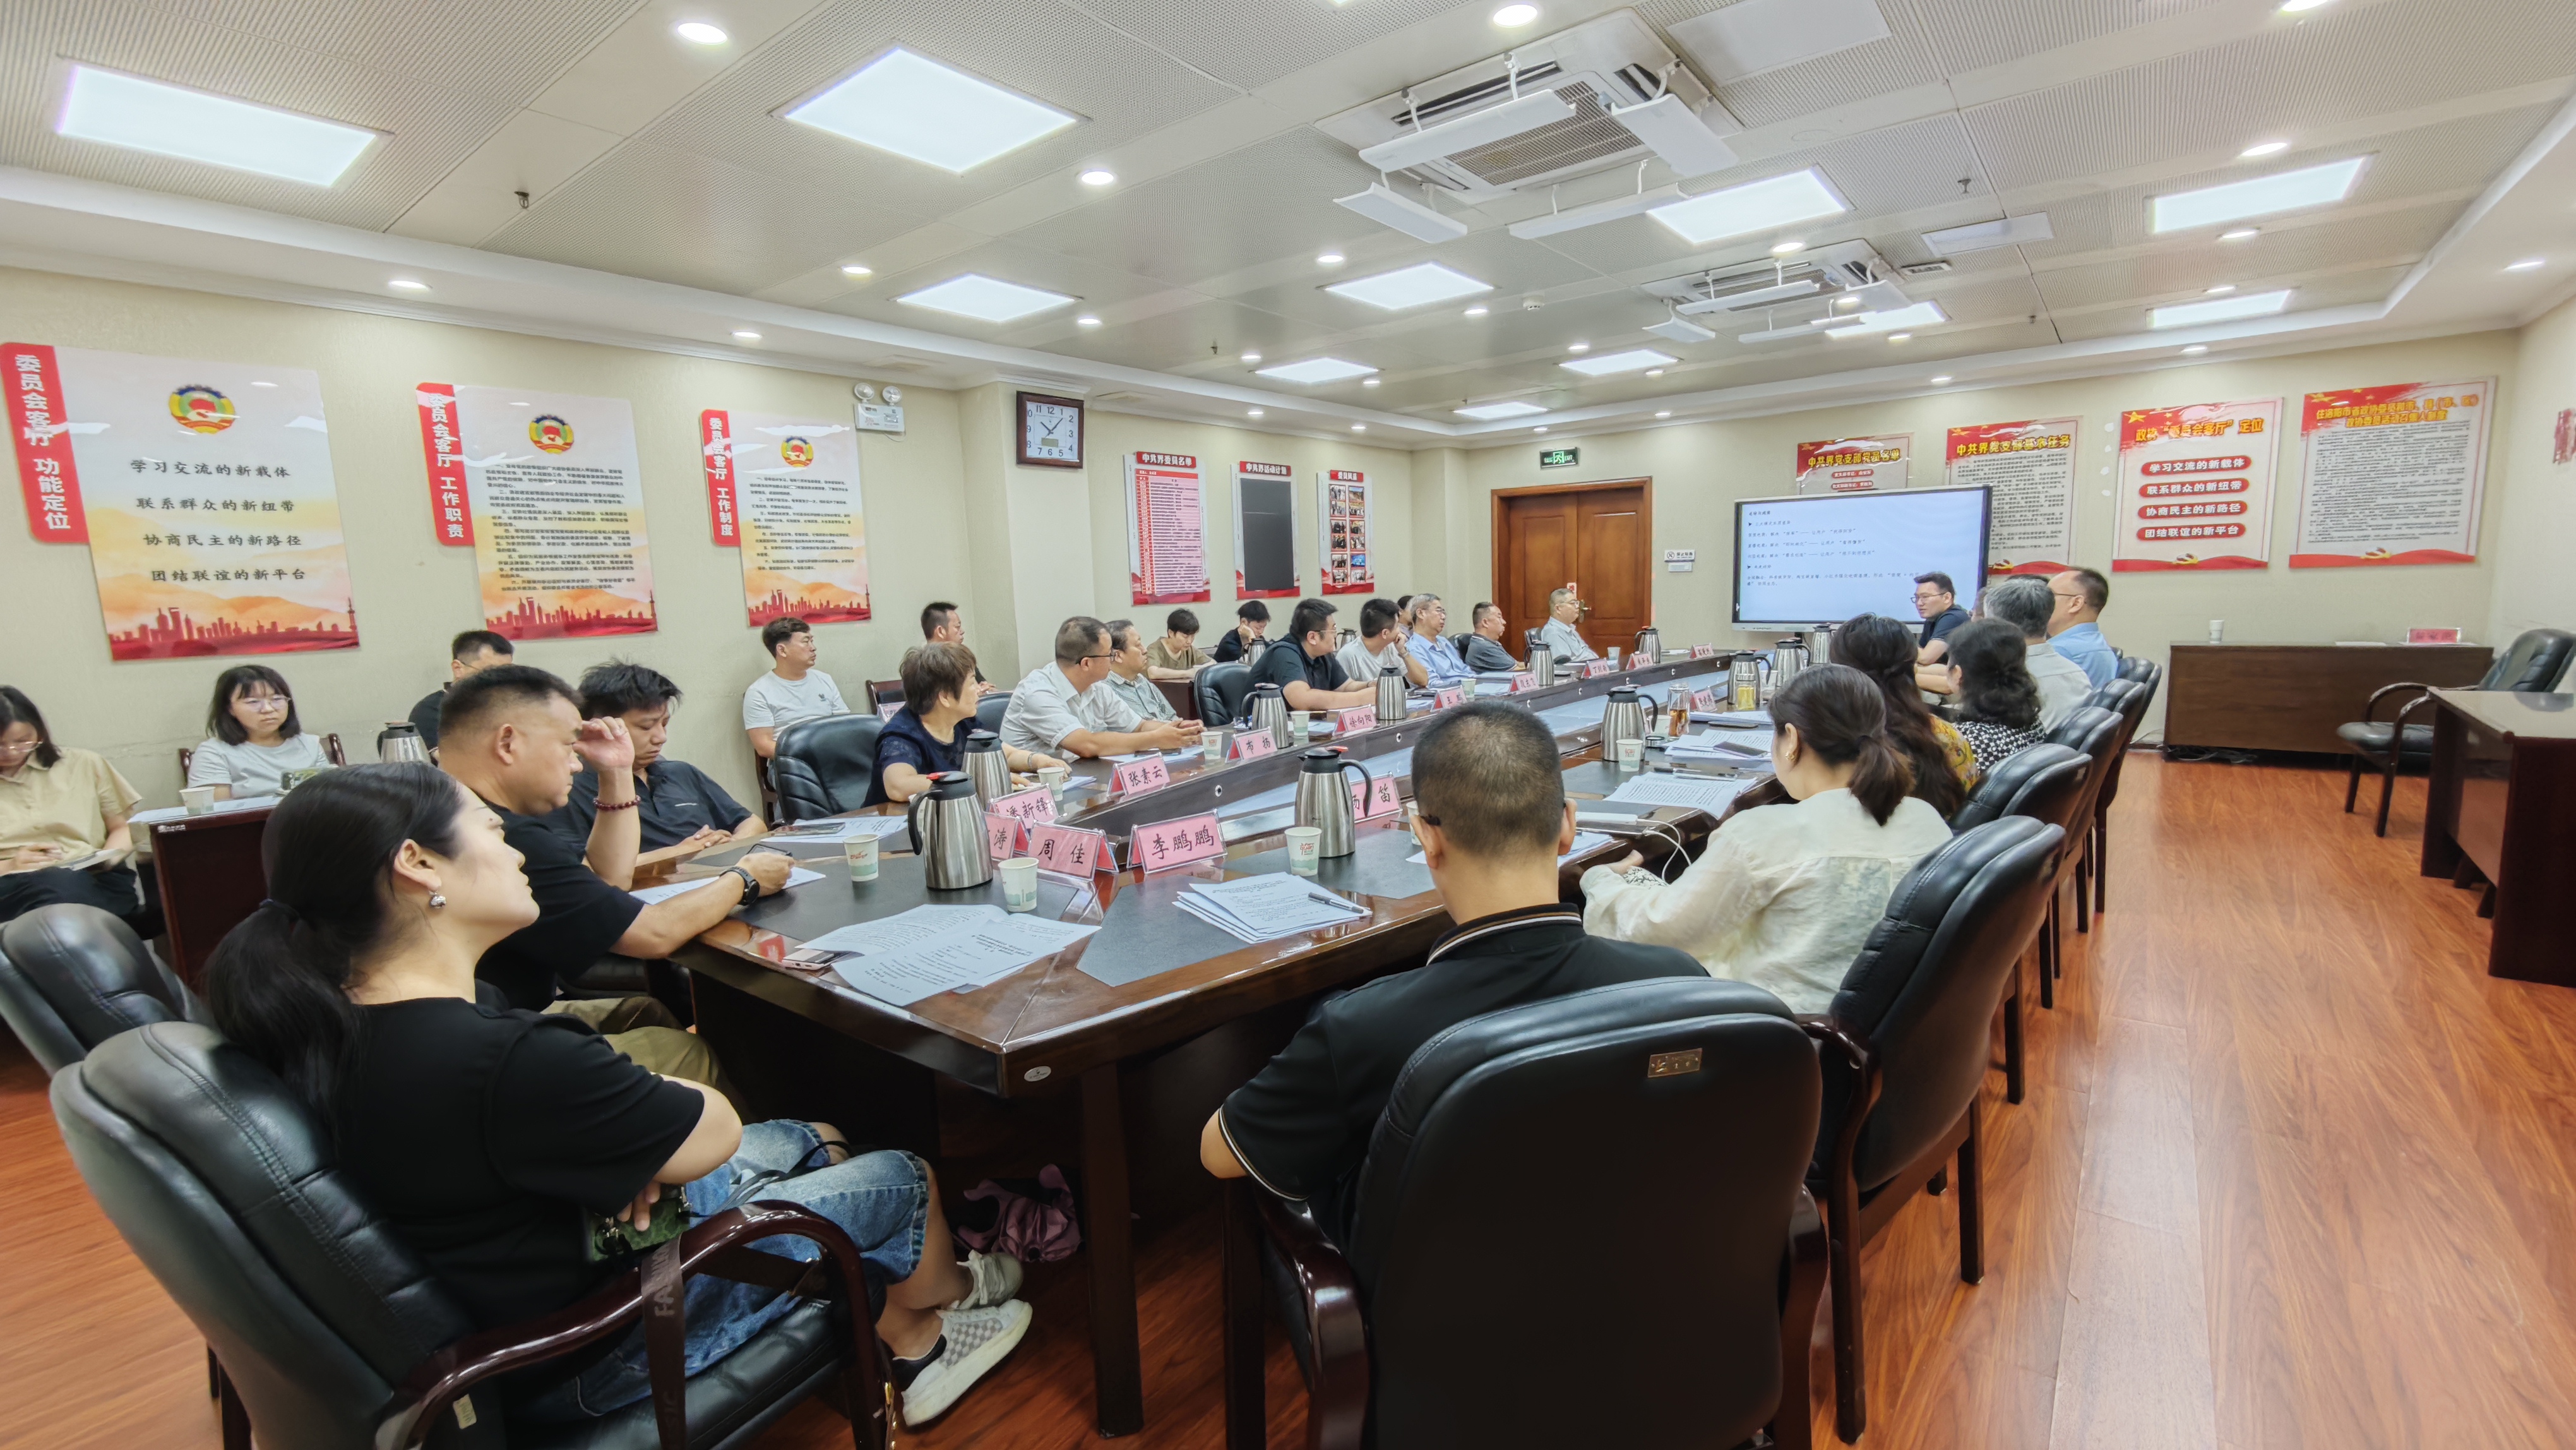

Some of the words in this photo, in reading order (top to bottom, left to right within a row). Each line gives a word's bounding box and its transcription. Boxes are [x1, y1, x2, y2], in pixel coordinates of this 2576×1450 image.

[15, 354, 54, 446] 委员会客厅
[1036, 405, 1042, 413] 11
[1047, 407, 1055, 415] 12
[1068, 415, 1074, 423] 2
[428, 393, 453, 468] 委员会客厅
[709, 417, 728, 481] 委员会客厅
[1037, 447, 1042, 455] 7
[1058, 449, 1064, 457] 5
[1068, 444, 1073, 452] 4
[1956, 434, 2071, 457] 中共界党支部基本任务
[1142, 453, 1193, 467] 中共界委员名单
[1808, 448, 1901, 468] 中共界党支部党员名单
[2149, 458, 2245, 474] 学习交流的新载体
[130, 459, 291, 478] 学习交流的新载体
[33, 457, 71, 530] 功能定位
[2147, 481, 2242, 495] 联系群众的新纽带
[136, 497, 295, 513] 联系群众的新纽带
[440, 476, 464, 538] 工作职责
[717, 487, 734, 536] 工作制度
[2146, 503, 2241, 517] 协商民主的新路径
[2145, 525, 2239, 538] 团结联谊的新平台
[143, 534, 302, 547] 协商民主的新路径
[152, 568, 306, 582] 团结联谊的新平台
[1128, 765, 1163, 788] 张素云
[1151, 824, 1215, 860] 李鹏鹏
